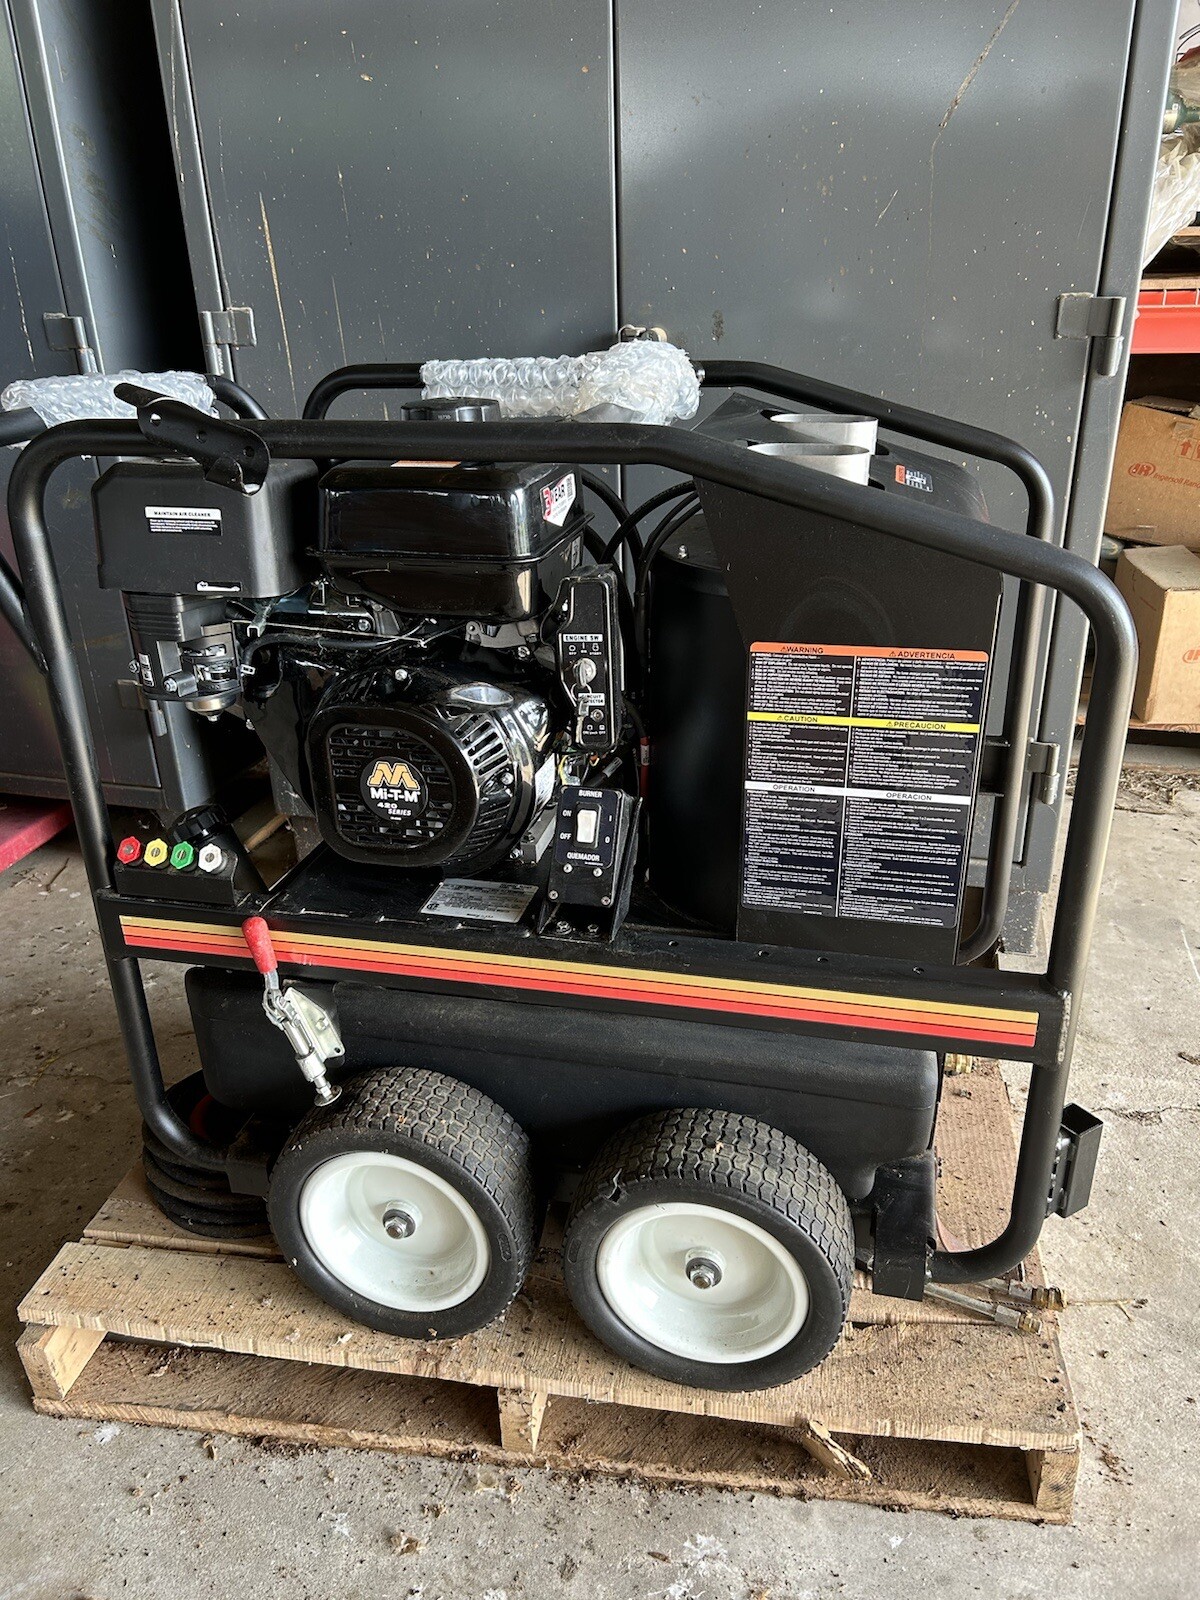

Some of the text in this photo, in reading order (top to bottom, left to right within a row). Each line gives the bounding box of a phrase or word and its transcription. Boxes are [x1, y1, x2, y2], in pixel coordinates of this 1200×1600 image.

[1153, 473, 1184, 484] Ingersoll
[786, 646, 824, 654] WARNING
[897, 651, 955, 660] ADVERTENCIA
[783, 715, 818, 723] CAUTION
[893, 721, 947, 730] PRECAUCION
[772, 784, 816, 792] OPERATION
[370, 787, 418, 803] Mi-T-M
[578, 789, 603, 798] BURNER
[885, 792, 933, 801] OPERACION
[562, 809, 572, 817] ON
[560, 832, 571, 840] OFF
[566, 852, 600, 861] QUEMADOR
